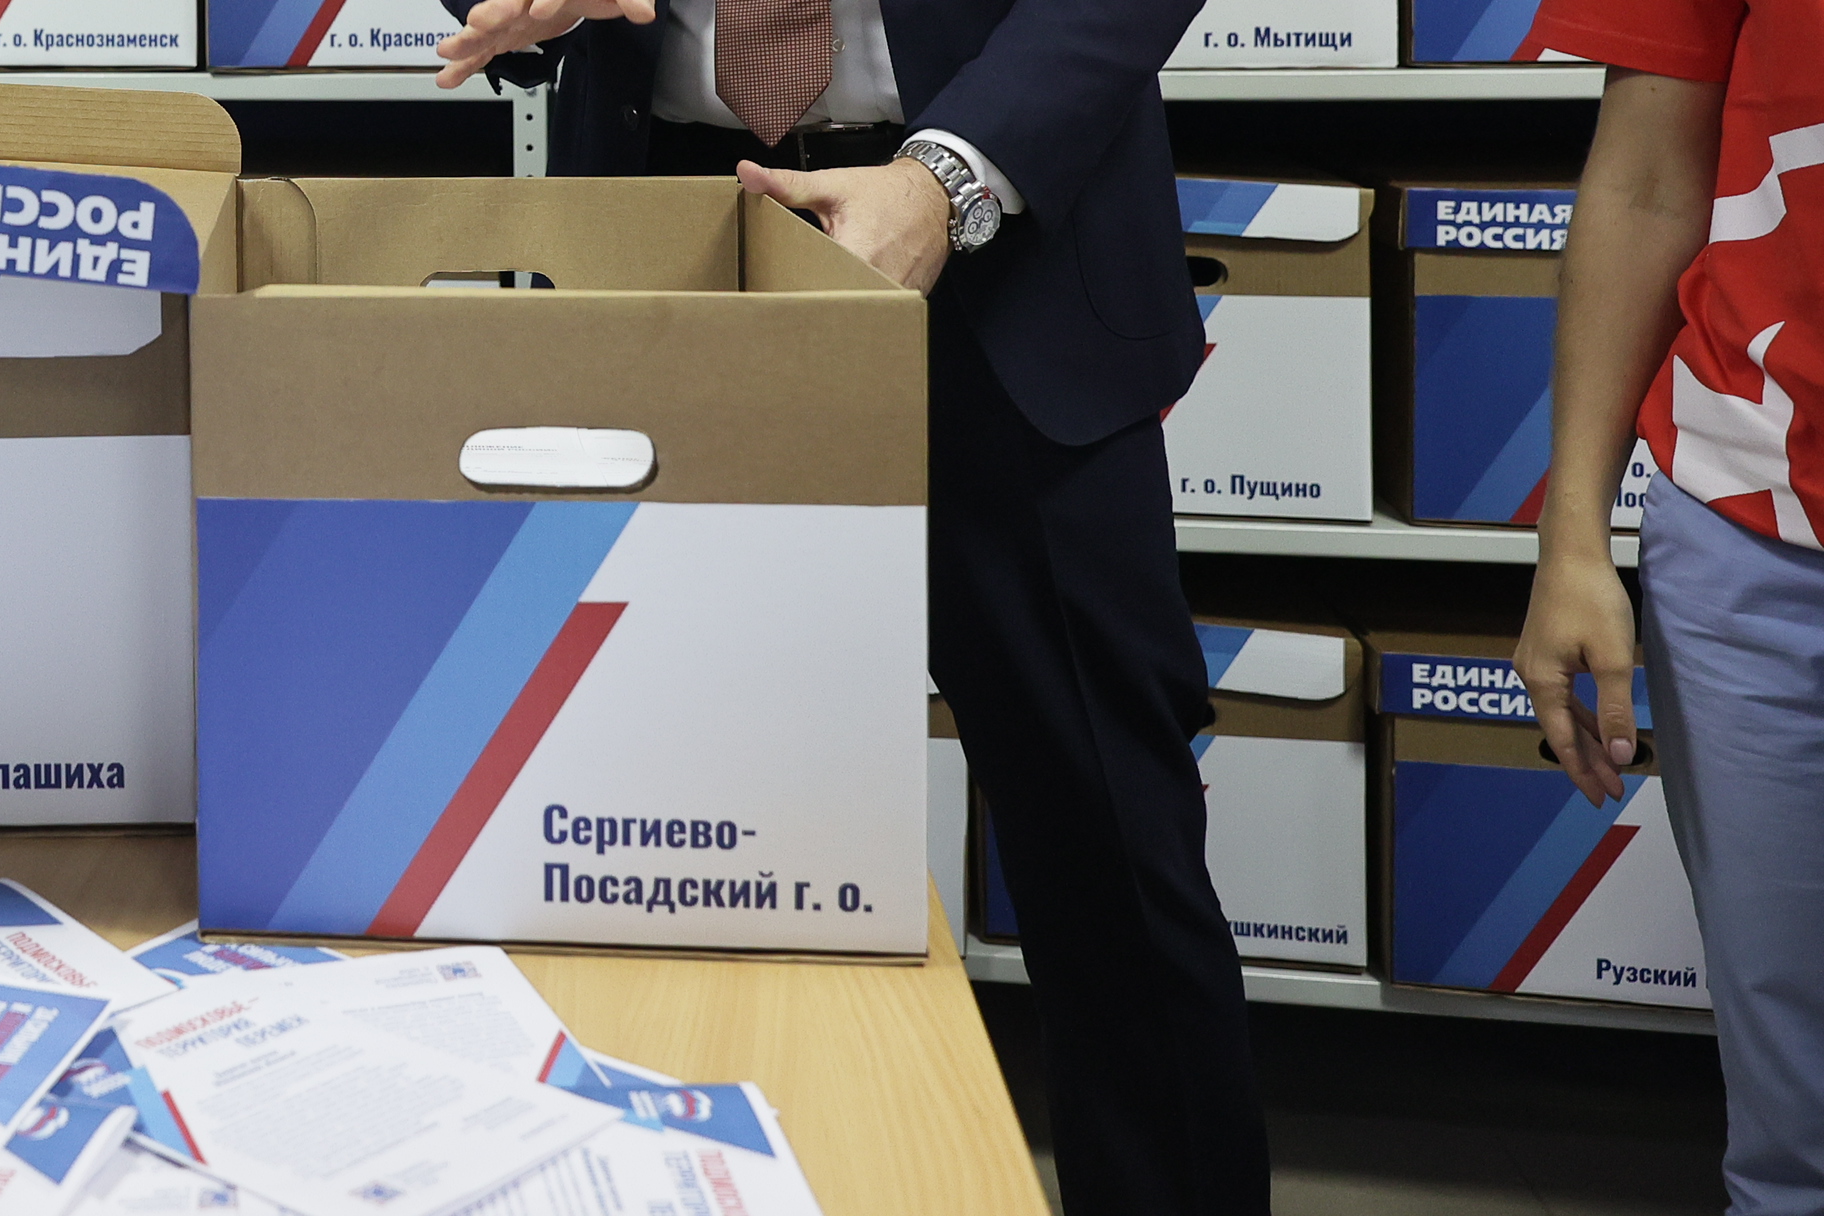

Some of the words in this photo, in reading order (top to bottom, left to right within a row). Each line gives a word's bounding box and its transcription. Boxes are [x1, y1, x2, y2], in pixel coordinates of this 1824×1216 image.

[13, 33, 27, 48] о.
[33, 28, 179, 51] Краснознаменск
[330, 33, 342, 48] г.
[348, 33, 364, 48] о.
[1204, 32, 1219, 48] г.
[1226, 32, 1245, 48] о.
[1254, 26, 1352, 51] Мытищи
[1436, 200, 1573, 225] ЕДИНАЯ
[1181, 478, 1196, 493] г.
[1203, 478, 1222, 495] о.
[1230, 474, 1321, 501] Пущино
[1412, 662, 1526, 690] ЕДИНА
[543, 804, 756, 856] Сергиево-
[544, 862, 778, 914] Посадский
[794, 881, 822, 911] г.
[838, 882, 873, 913] о.
[1229, 920, 1348, 945] шкинский
[1596, 958, 1697, 989] Рузский
